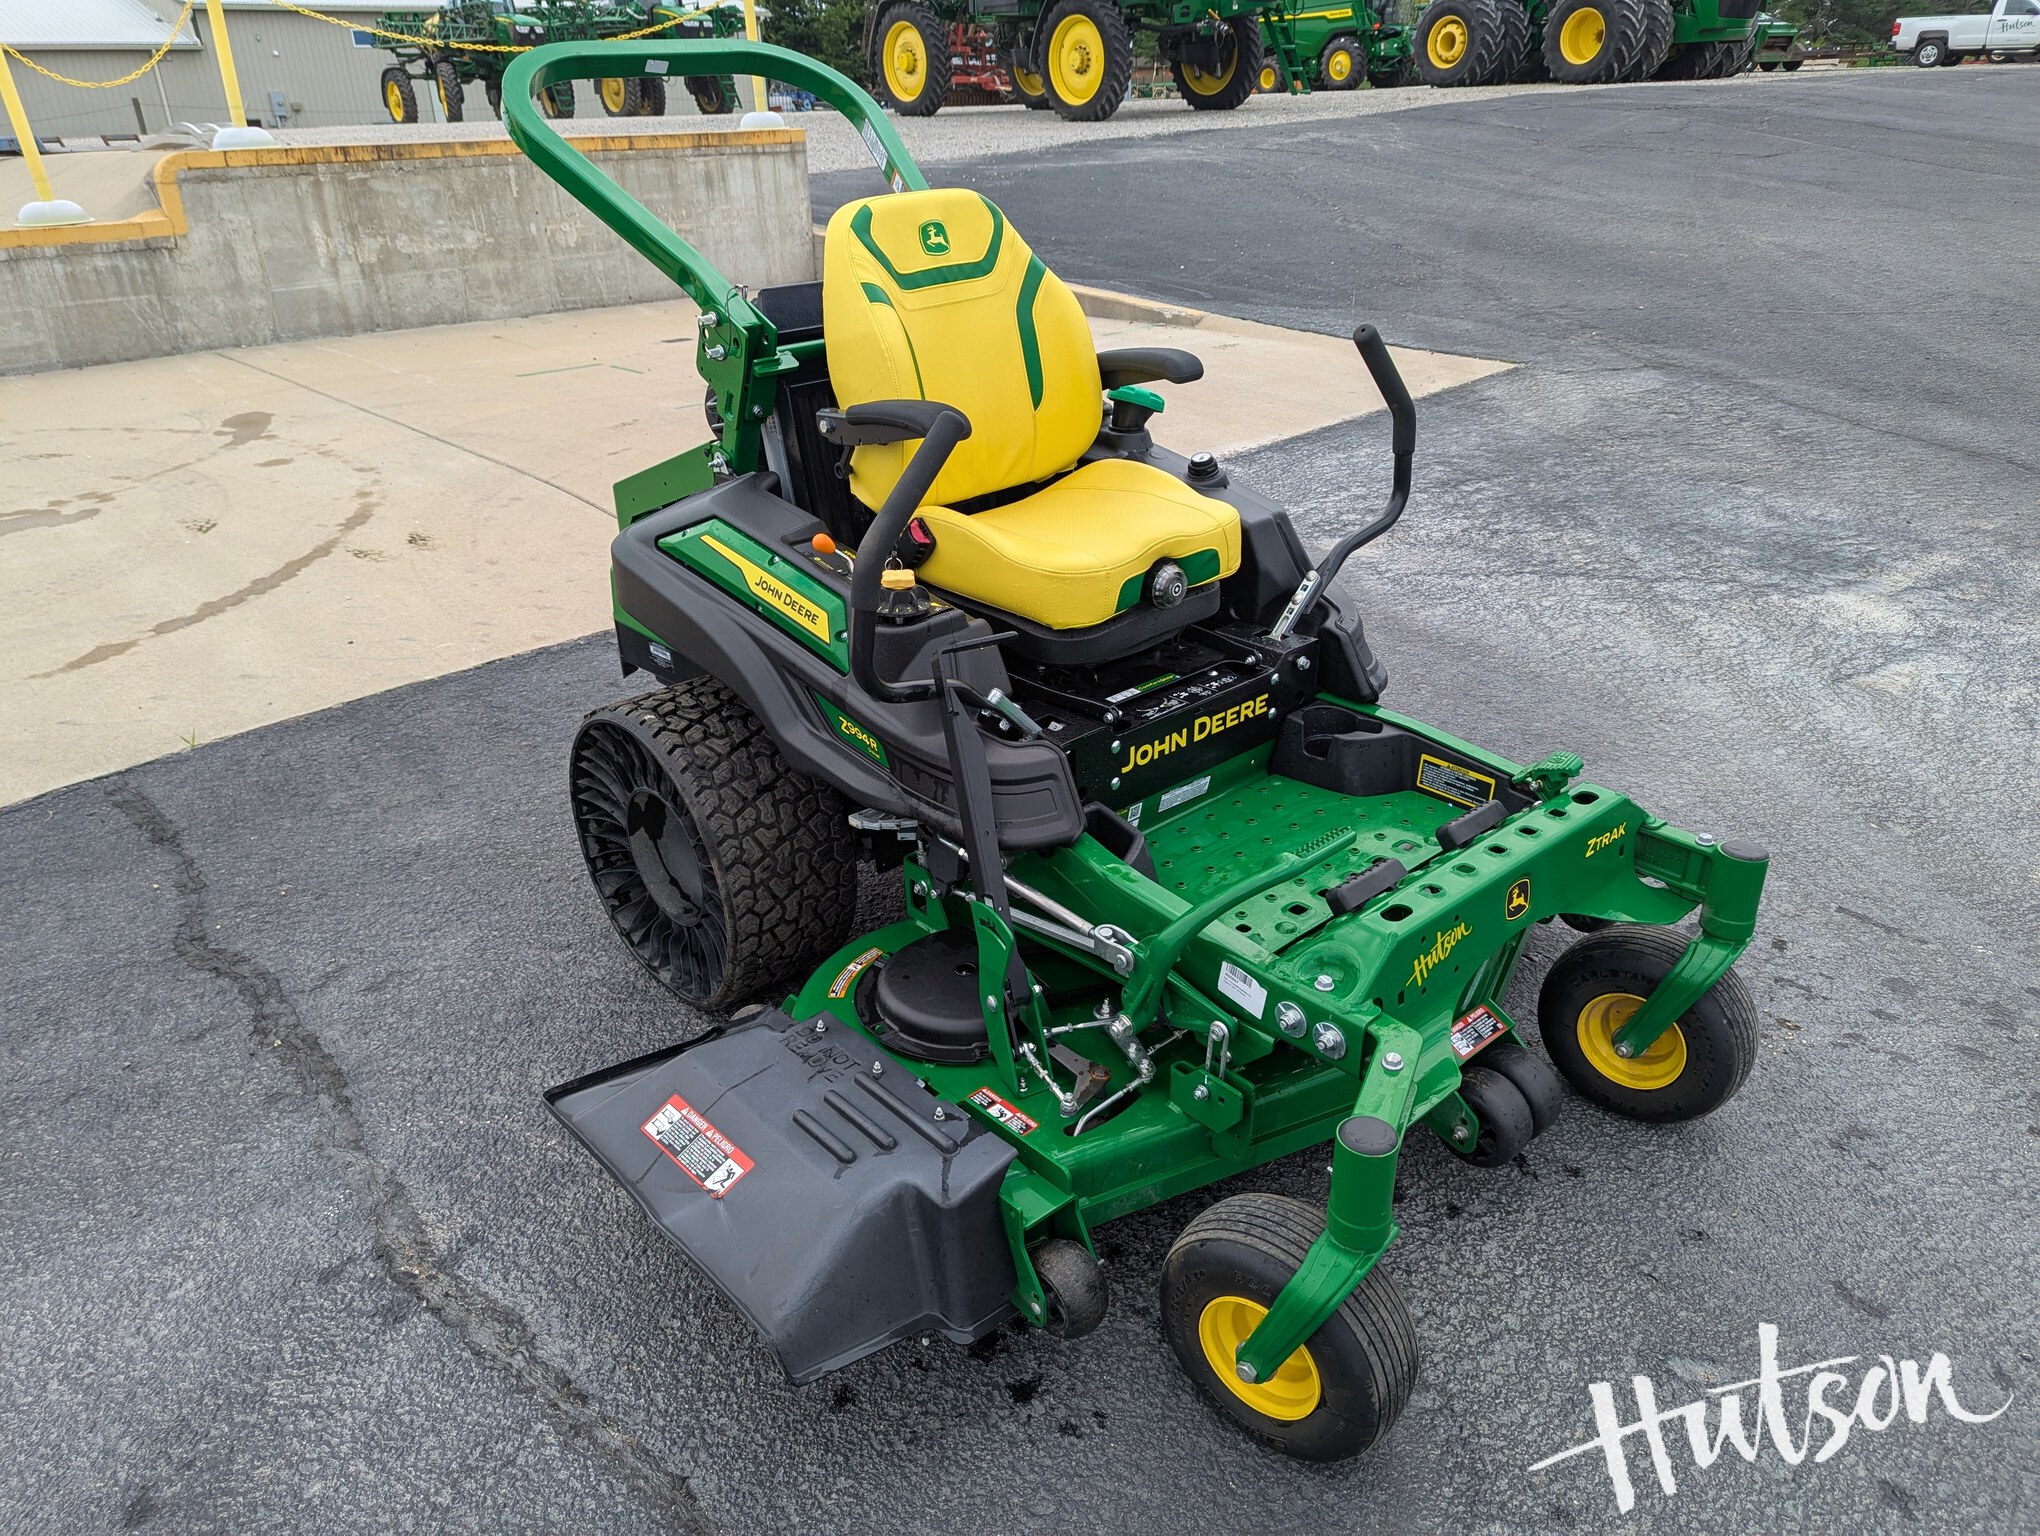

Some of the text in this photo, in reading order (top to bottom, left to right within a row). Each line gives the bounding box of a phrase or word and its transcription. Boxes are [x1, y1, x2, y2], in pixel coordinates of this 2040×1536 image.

[1996, 19, 2035, 33] Hutson
[755, 576, 819, 625] JOHN DEERE
[838, 716, 878, 752] Z994R
[1121, 693, 1269, 774] JOHN DEERE
[1585, 821, 1627, 858] ZTRAK
[1405, 922, 1473, 987] Hutson
[818, 1046, 861, 1070] NOT
[687, 1110, 709, 1131] DANGER
[711, 1132, 735, 1155] PELIGRO
